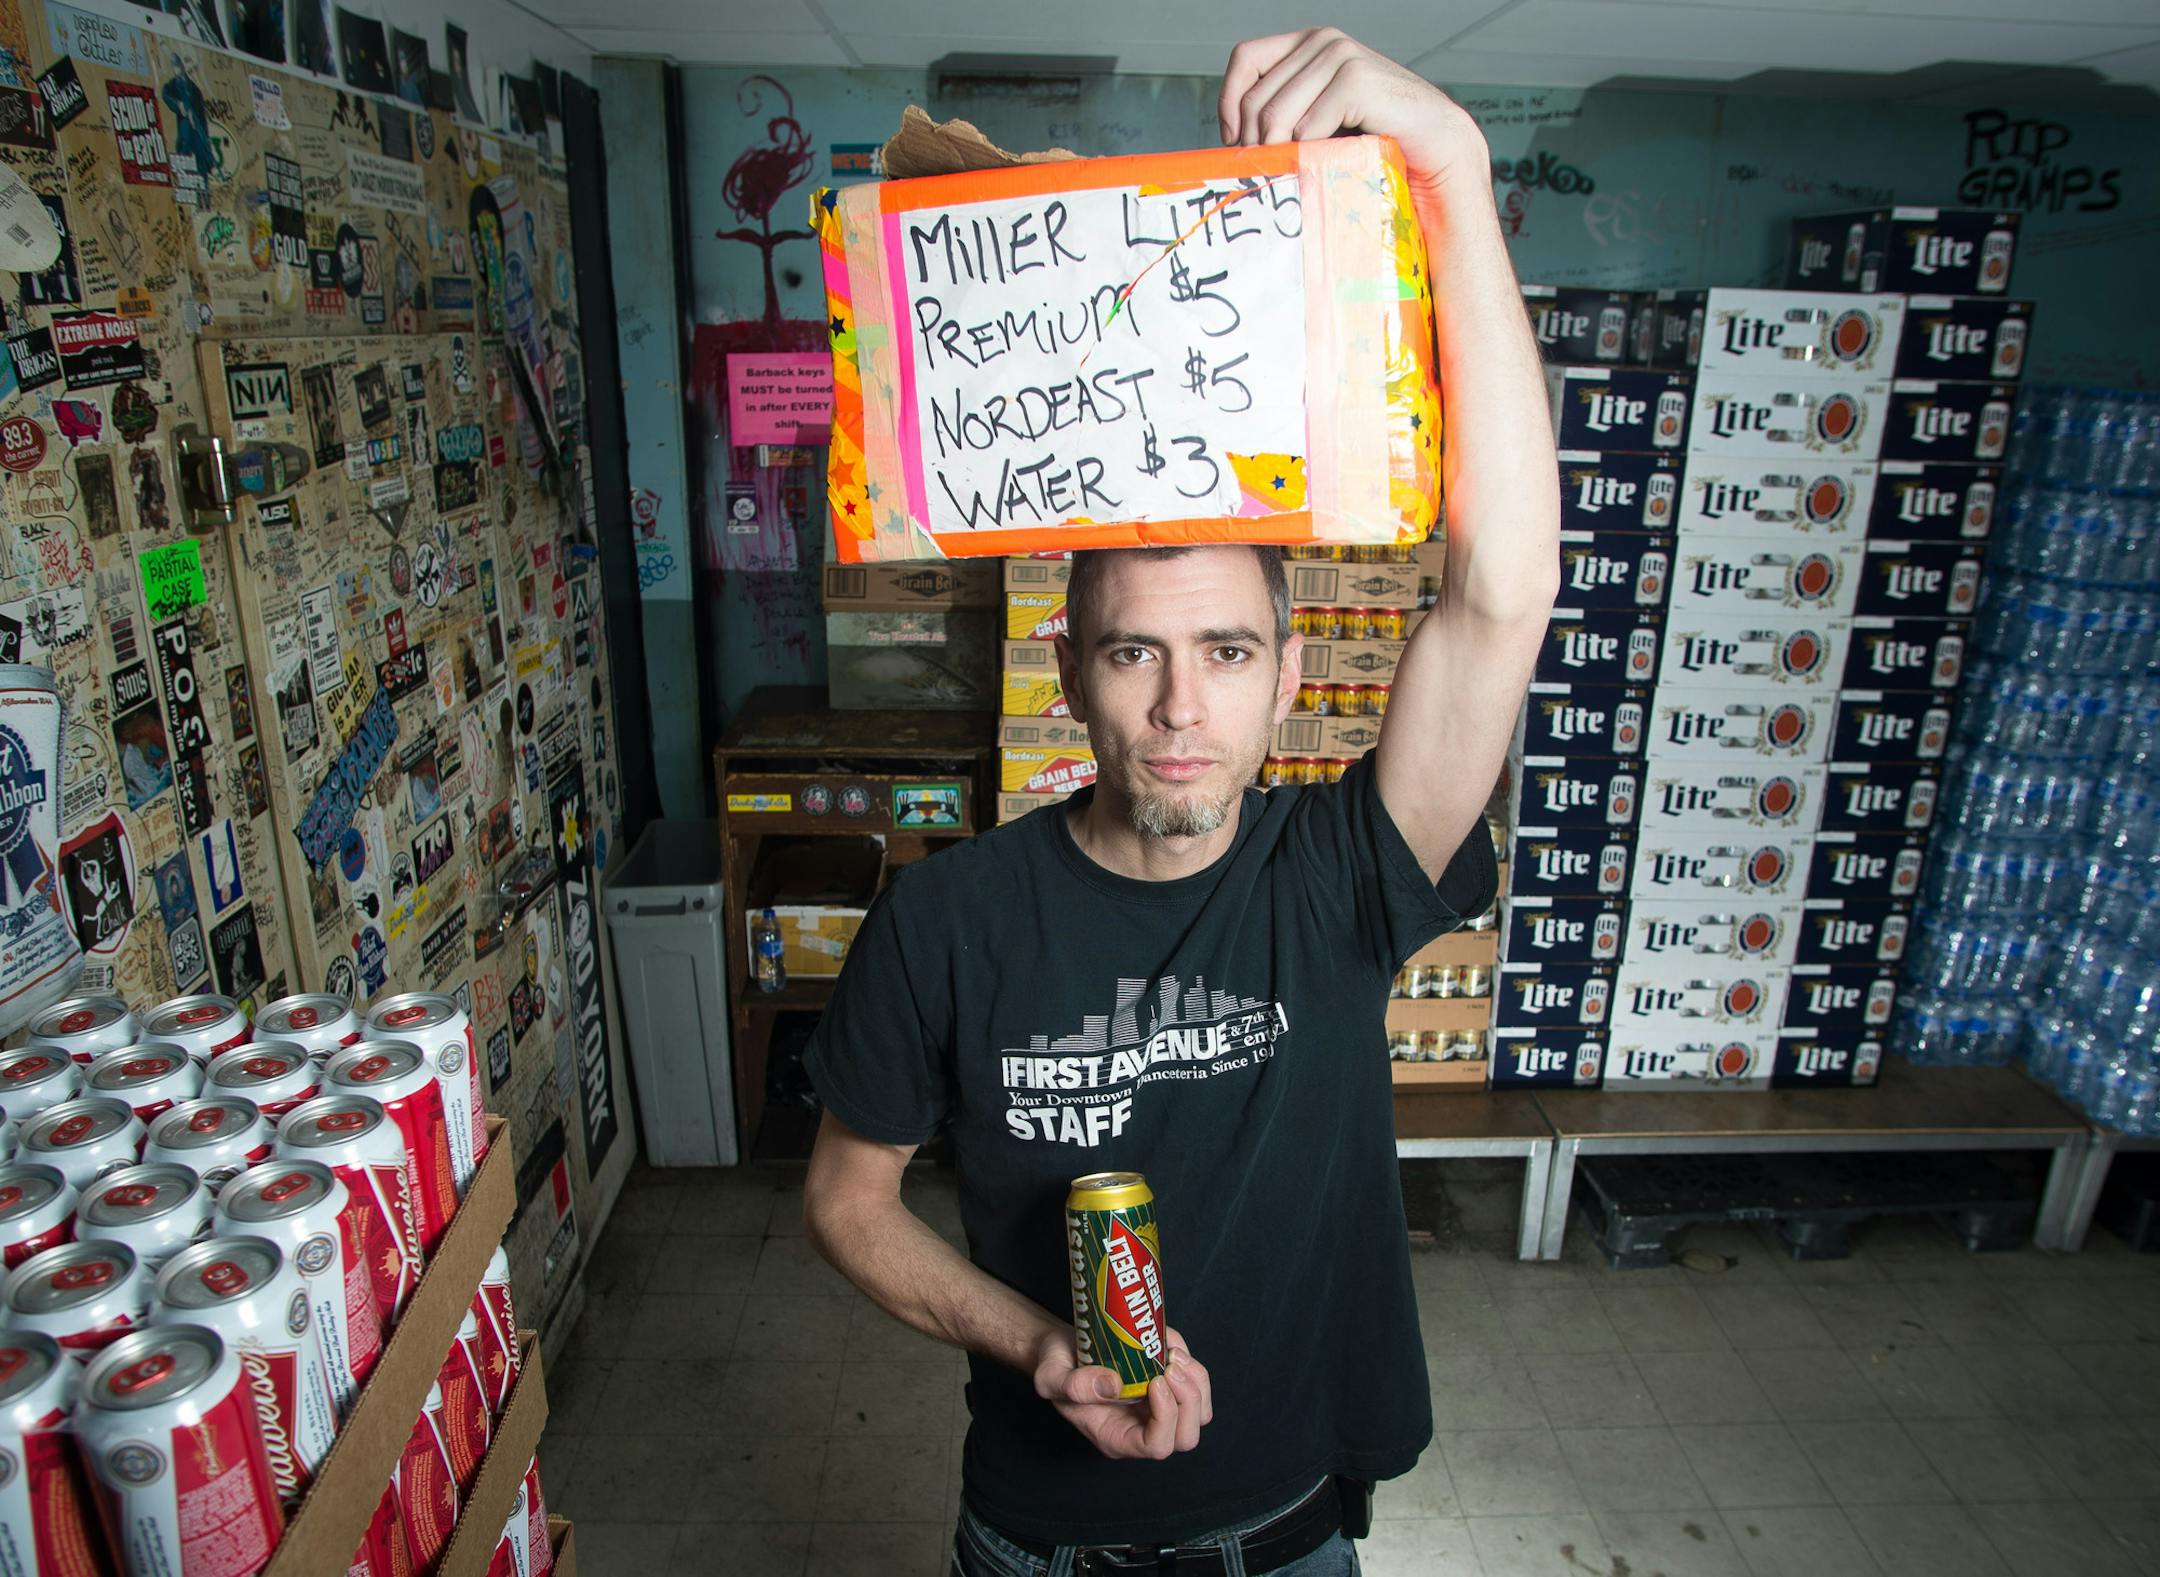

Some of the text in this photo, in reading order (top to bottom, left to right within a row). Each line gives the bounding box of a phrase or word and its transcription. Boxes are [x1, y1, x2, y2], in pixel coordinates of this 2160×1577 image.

[118, 127, 167, 166] the earth
[1964, 108, 2070, 169] RIP
[1956, 165, 2123, 215] GRAMPS
[274, 233, 308, 266] GOLD
[1911, 234, 1974, 276] Lite
[1169, 252, 1241, 338] $5
[56, 319, 137, 344] EXTREME NOISE
[1537, 308, 1590, 344] Lite
[1722, 315, 1785, 356] Lite
[1925, 323, 1988, 362] Lite
[8, 338, 30, 362] THE
[18, 350, 58, 379] BRIGGS
[740, 384, 833, 394] MUST be turned
[746, 367, 825, 378] Barback keys
[745, 402, 829, 412] in after EVERY
[931, 346, 1253, 459] NORDEAST $5
[1585, 392, 1647, 432] Lite
[1710, 399, 1772, 438] Lite
[2, 422, 34, 451] 89.3
[1910, 406, 1972, 443] Lite
[938, 422, 1220, 530] WATER $3
[1576, 475, 1637, 513] Lite
[1698, 481, 1760, 520] Lite
[1897, 486, 1957, 523] Lite
[150, 556, 196, 584] PARTIAL
[1569, 554, 1630, 592] Lite
[1691, 560, 1751, 597] Lite
[1885, 564, 1943, 599] Lite
[162, 578, 193, 602] CASE
[1035, 616, 1068, 638] GRAI
[1561, 630, 1619, 668] Lite
[1680, 636, 1739, 672] Lite
[1869, 639, 1927, 675] Lite
[1548, 706, 1606, 742] Lite
[1666, 711, 1725, 745] Lite
[1856, 712, 1914, 747] Lite
[1028, 767, 1070, 789] GRAIN
[1543, 777, 1599, 813] Lite
[1661, 783, 1717, 817] Lite
[1845, 784, 1902, 817] Lite
[1535, 848, 1591, 882] Lite
[1651, 853, 1706, 885] Lite
[1831, 852, 1887, 885] Lite
[1531, 917, 1585, 950] Lite
[1644, 921, 1699, 952] Lite
[1819, 919, 1874, 951] Lite
[1519, 983, 1574, 1014] Lite
[1630, 986, 1684, 1017] Lite
[1807, 983, 1861, 1015] Lite
[1011, 1011, 1265, 1090] FIRST AVENUE & 7th
[1514, 1047, 1568, 1078] Lite
[1622, 1050, 1676, 1080] Lite
[1795, 1047, 1848, 1077] Lite
[1008, 1091, 1043, 1107] Your
[1046, 1087, 1133, 1106] Downtown
[1210, 1055, 1249, 1076] Since
[1005, 1097, 1133, 1148] STAFF
[1103, 1235, 1163, 1360] GRAIN BELT
[1141, 1260, 1163, 1311] BEER
